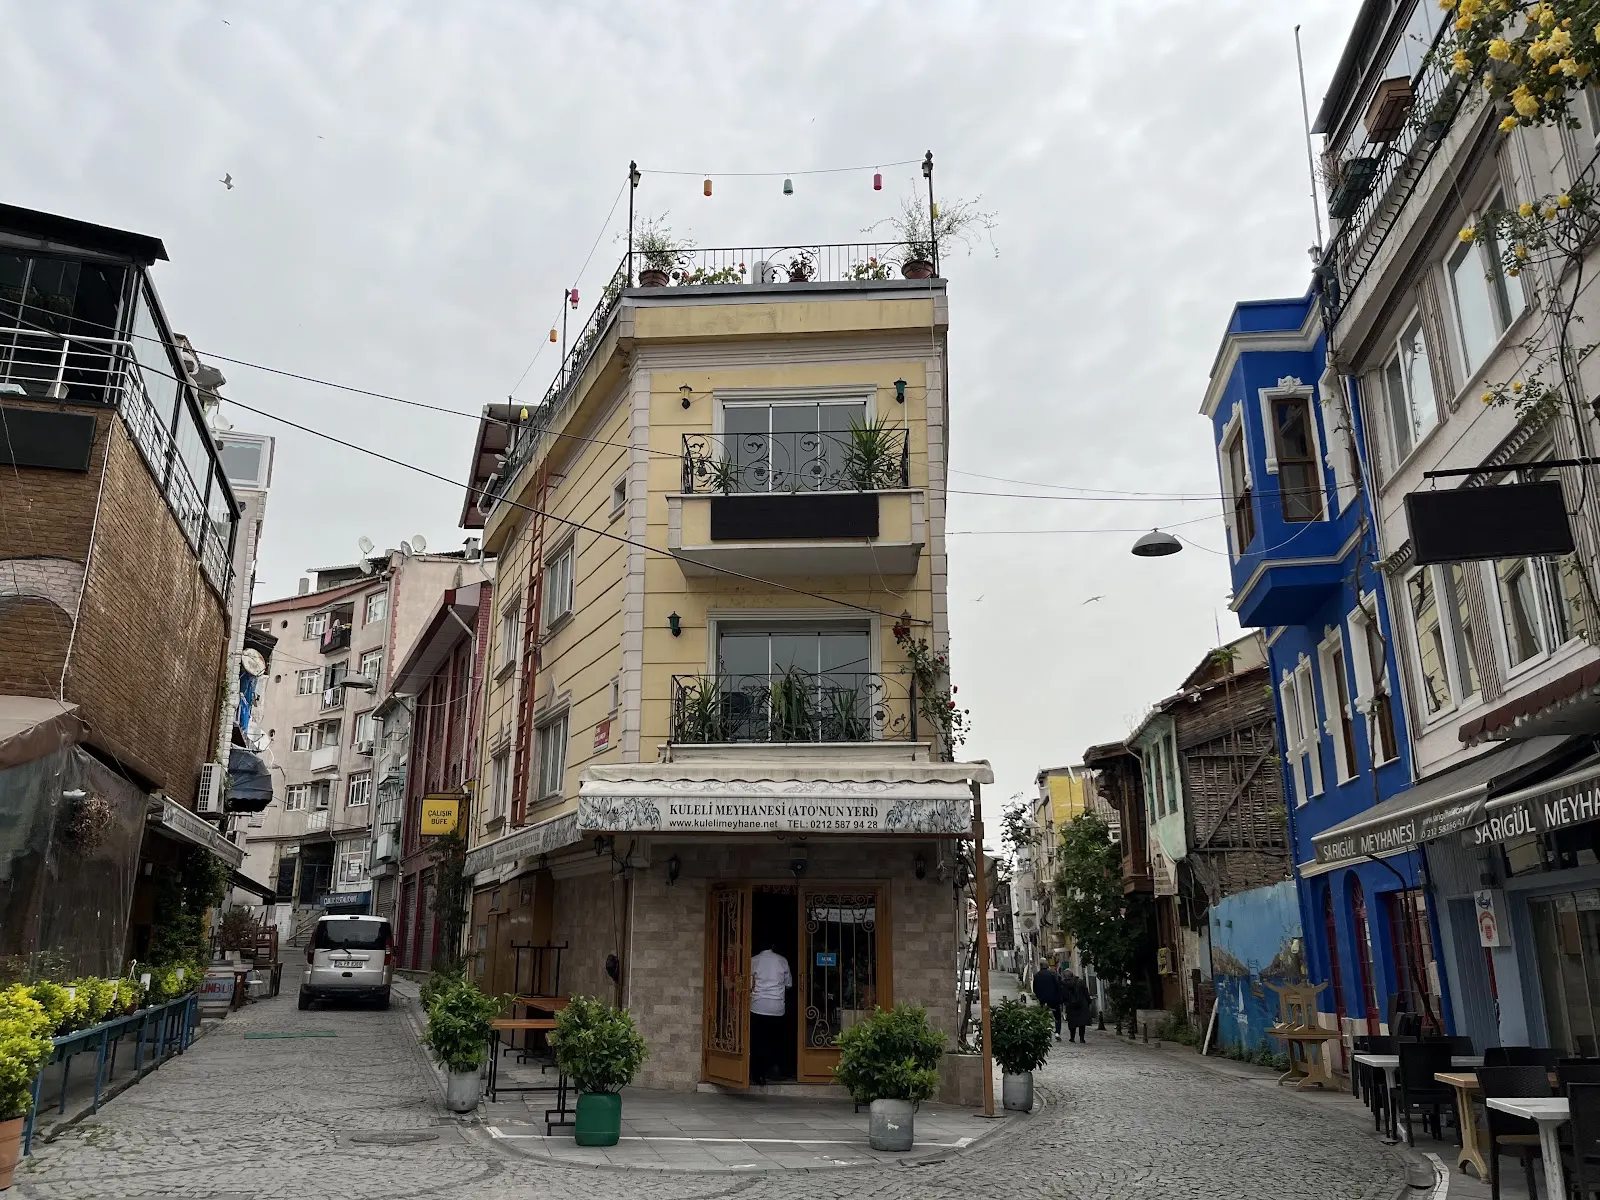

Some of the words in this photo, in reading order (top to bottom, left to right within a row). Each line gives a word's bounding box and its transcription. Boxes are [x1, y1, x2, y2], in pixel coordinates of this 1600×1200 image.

[427, 810, 453, 818] ÇALIŞIR
[670, 801, 713, 815] KULELİ
[715, 802, 786, 816] MEYHANESİ
[846, 803, 878, 818] YERİ)
[431, 817, 448, 825] BÜFE
[669, 818, 778, 829] www.kulelimeyhane.net
[787, 819, 809, 829] TEL:
[810, 820, 832, 829] 0212
[834, 820, 851, 829] 587
[853, 820, 865, 829] 94
[867, 820, 878, 829] 28
[1474, 805, 1536, 845] SARIGÜL
[1323, 836, 1357, 861] SARIGÜL
[1361, 818, 1416, 854] MEYHANESİ
